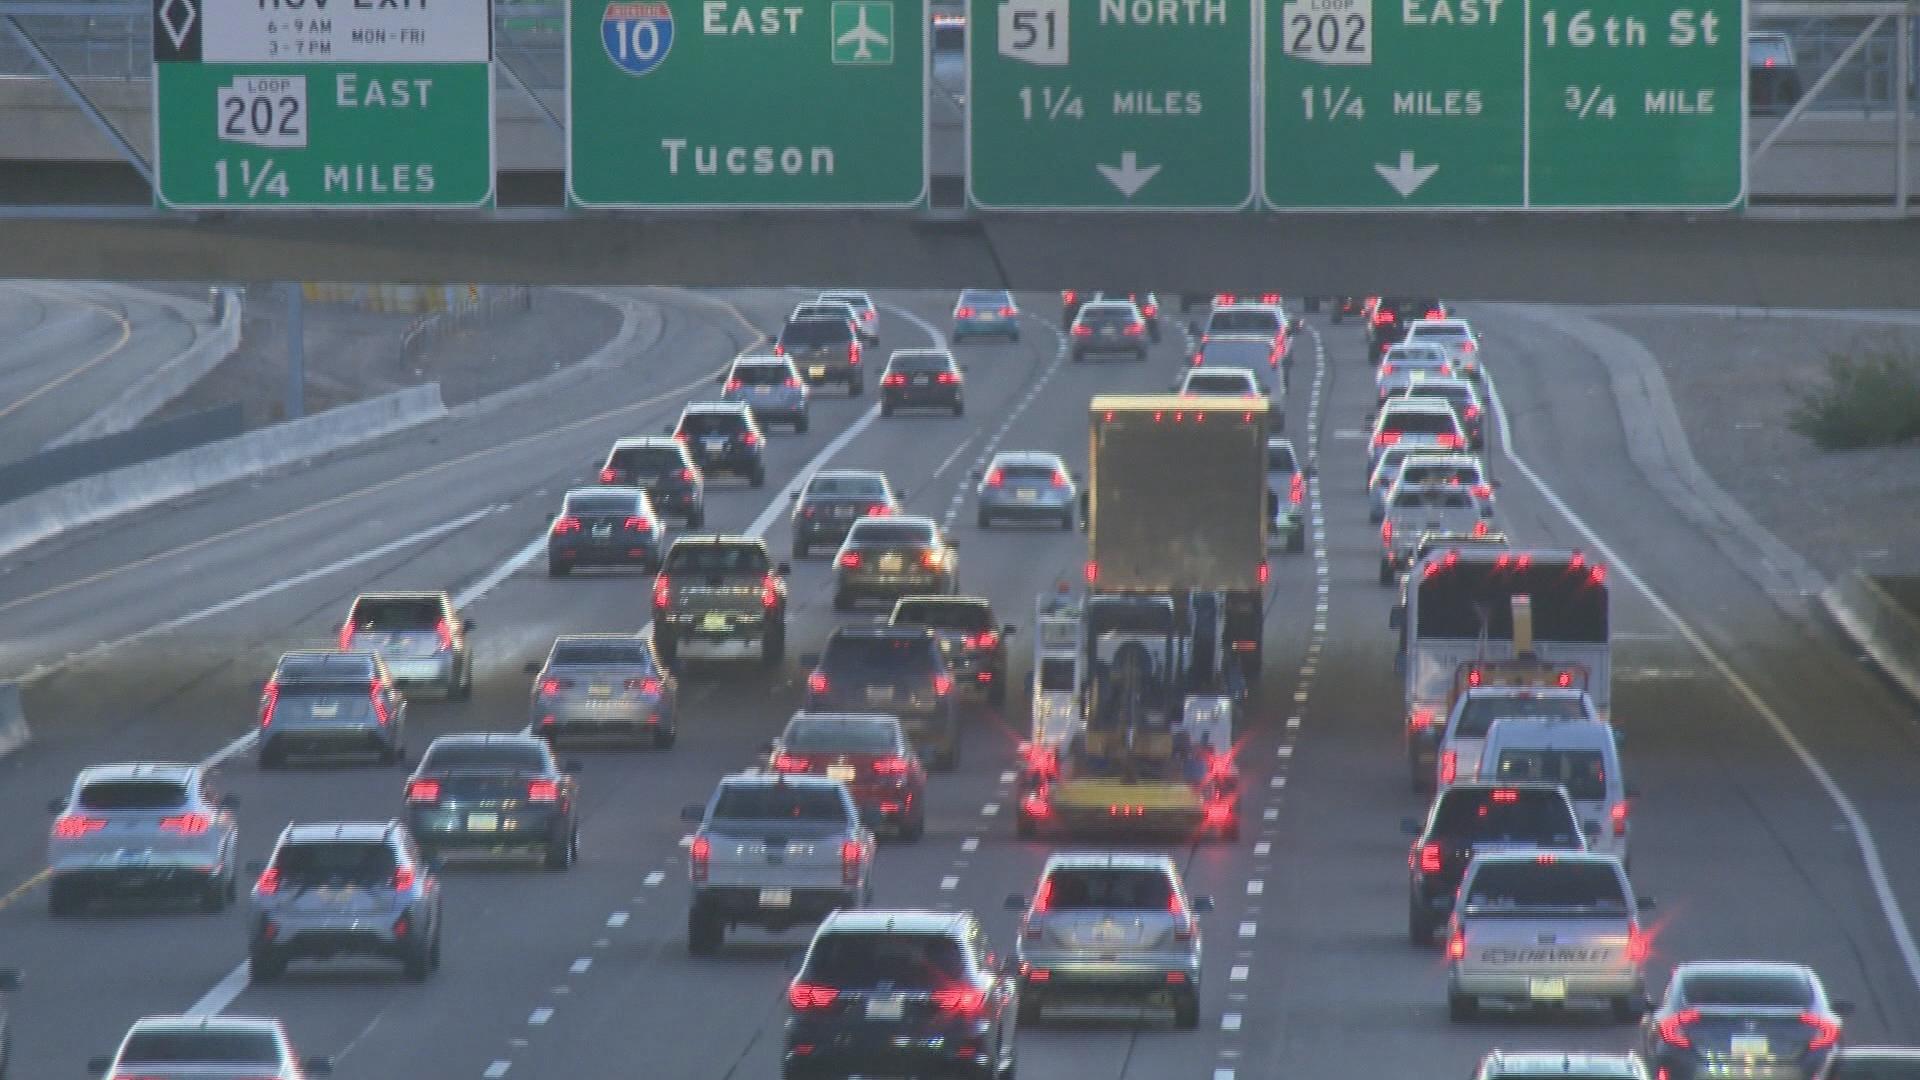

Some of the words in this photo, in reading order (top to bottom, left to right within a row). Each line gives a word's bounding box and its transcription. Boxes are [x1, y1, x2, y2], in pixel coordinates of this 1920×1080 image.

[703, 1, 804, 34] EAST
[1099, 0, 1227, 24] NORTH
[1402, 0, 1501, 24] EAST
[1542, 10, 1647, 47] 16th
[1668, 10, 1719, 46] St
[615, 20, 660, 60] 10
[1012, 11, 1057, 50] 51
[1290, 14, 1367, 53] 202
[247, 79, 290, 92] LOOP
[336, 73, 434, 107] EAST
[224, 97, 300, 136] 202
[1112, 91, 1203, 115] MILES
[1392, 91, 1483, 115] MILES
[1644, 90, 1716, 115] MILE
[661, 138, 835, 175] Tucson
[323, 164, 436, 192] MILES
